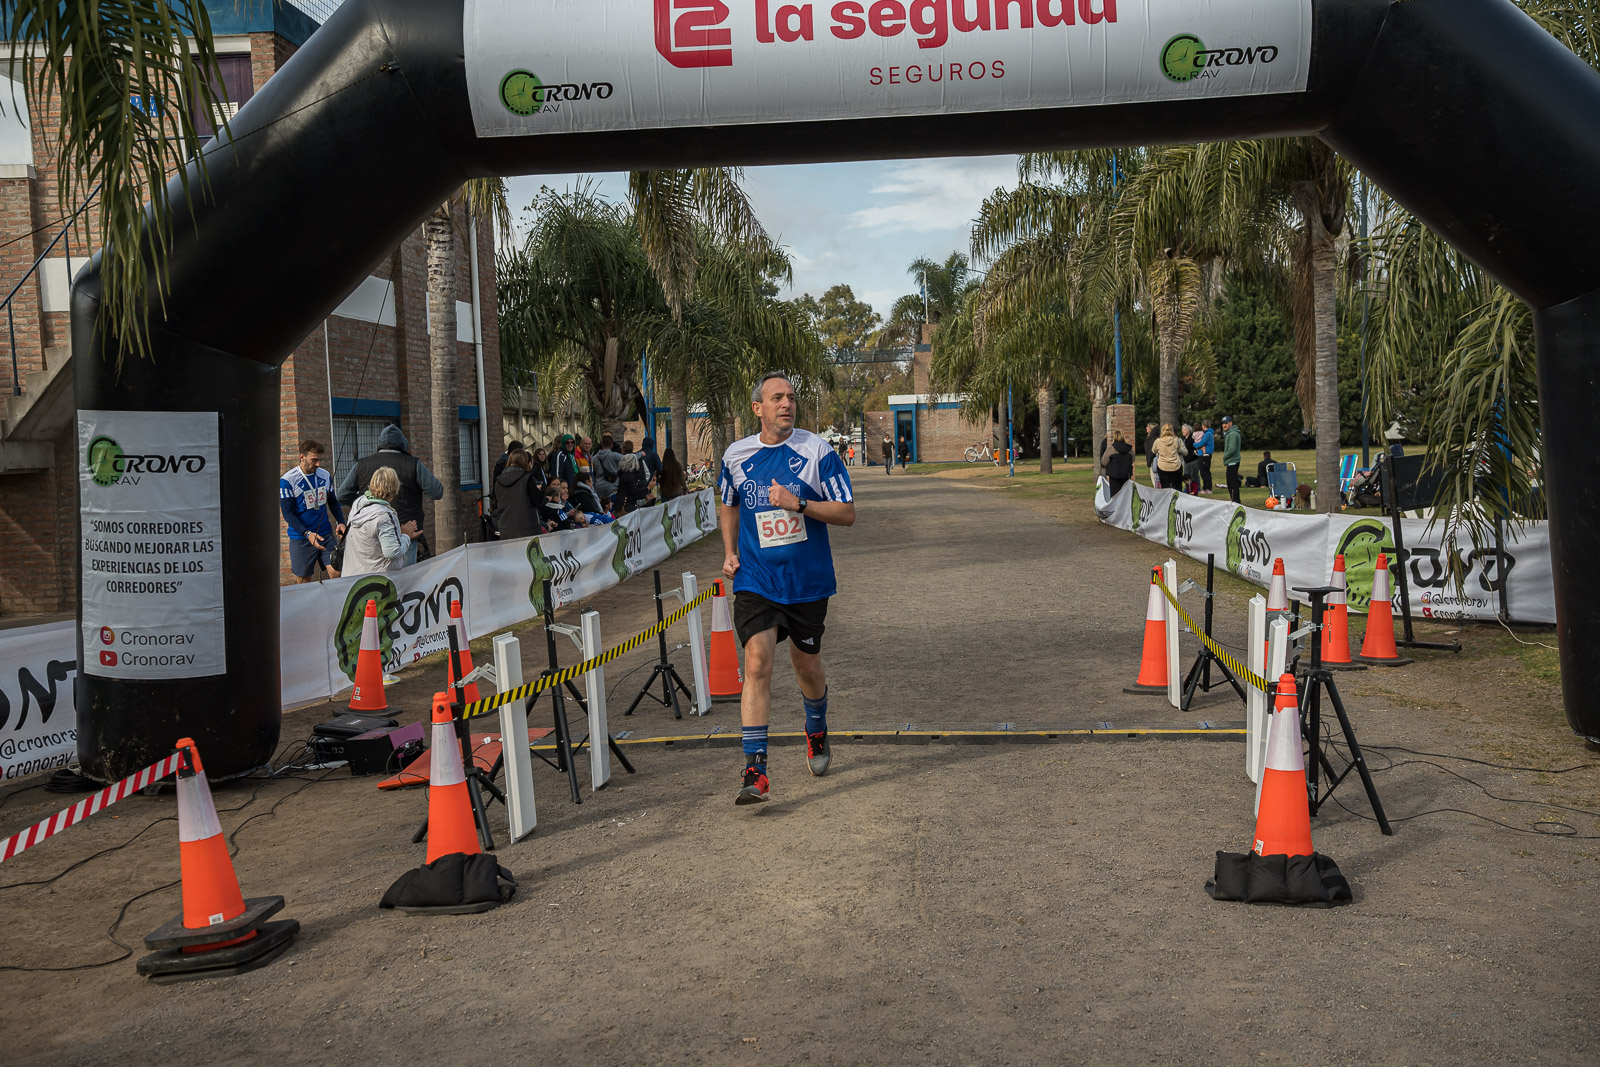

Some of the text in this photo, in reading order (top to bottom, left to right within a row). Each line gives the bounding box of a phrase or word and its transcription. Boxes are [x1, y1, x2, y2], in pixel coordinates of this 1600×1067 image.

[754, 0, 814, 44] la
[1193, 45, 1279, 68] CRONO
[869, 60, 1006, 86] SEGUROS
[1190, 69, 1220, 80] RAV
[531, 82, 614, 102] CRONO
[532, 104, 560, 114] RAV
[112, 454, 206, 473] CRONO
[110, 475, 141, 485] RAV
[127, 521, 203, 535] CORREDORES
[762, 516, 802, 538] 502
[85, 538, 214, 555] BUSCANDO MEJORAR LAS
[91, 558, 204, 574] EXPERIENCIAS DE LOS
[120, 631, 195, 646] Cronorav
[121, 651, 195, 666] Cronorav
[0, 728, 77, 760] @cronora
[6, 751, 74, 780] cronorav
